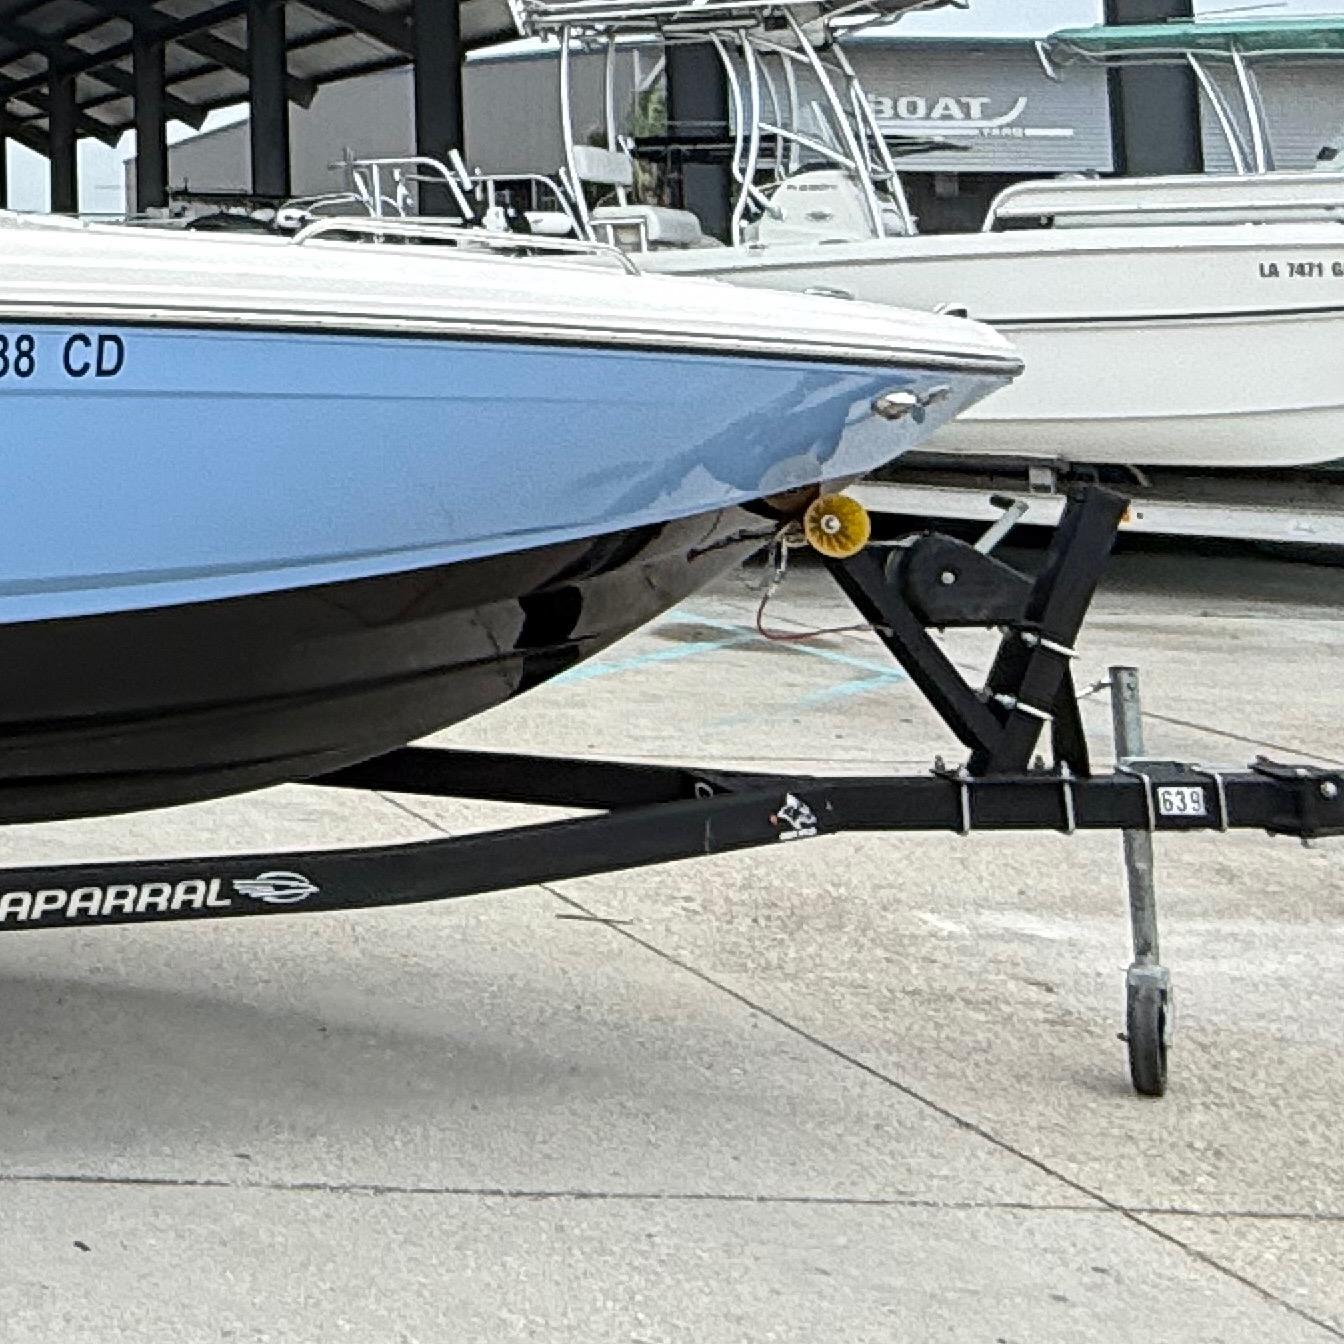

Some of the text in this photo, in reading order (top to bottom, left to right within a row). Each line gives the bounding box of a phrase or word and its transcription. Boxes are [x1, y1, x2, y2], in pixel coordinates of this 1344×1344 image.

[869, 95, 992, 120] BOAT
[1259, 262, 1280, 277] LA
[1287, 262, 1323, 277] 7471
[63, 333, 125, 378] CD
[1161, 790, 1200, 812] 639
